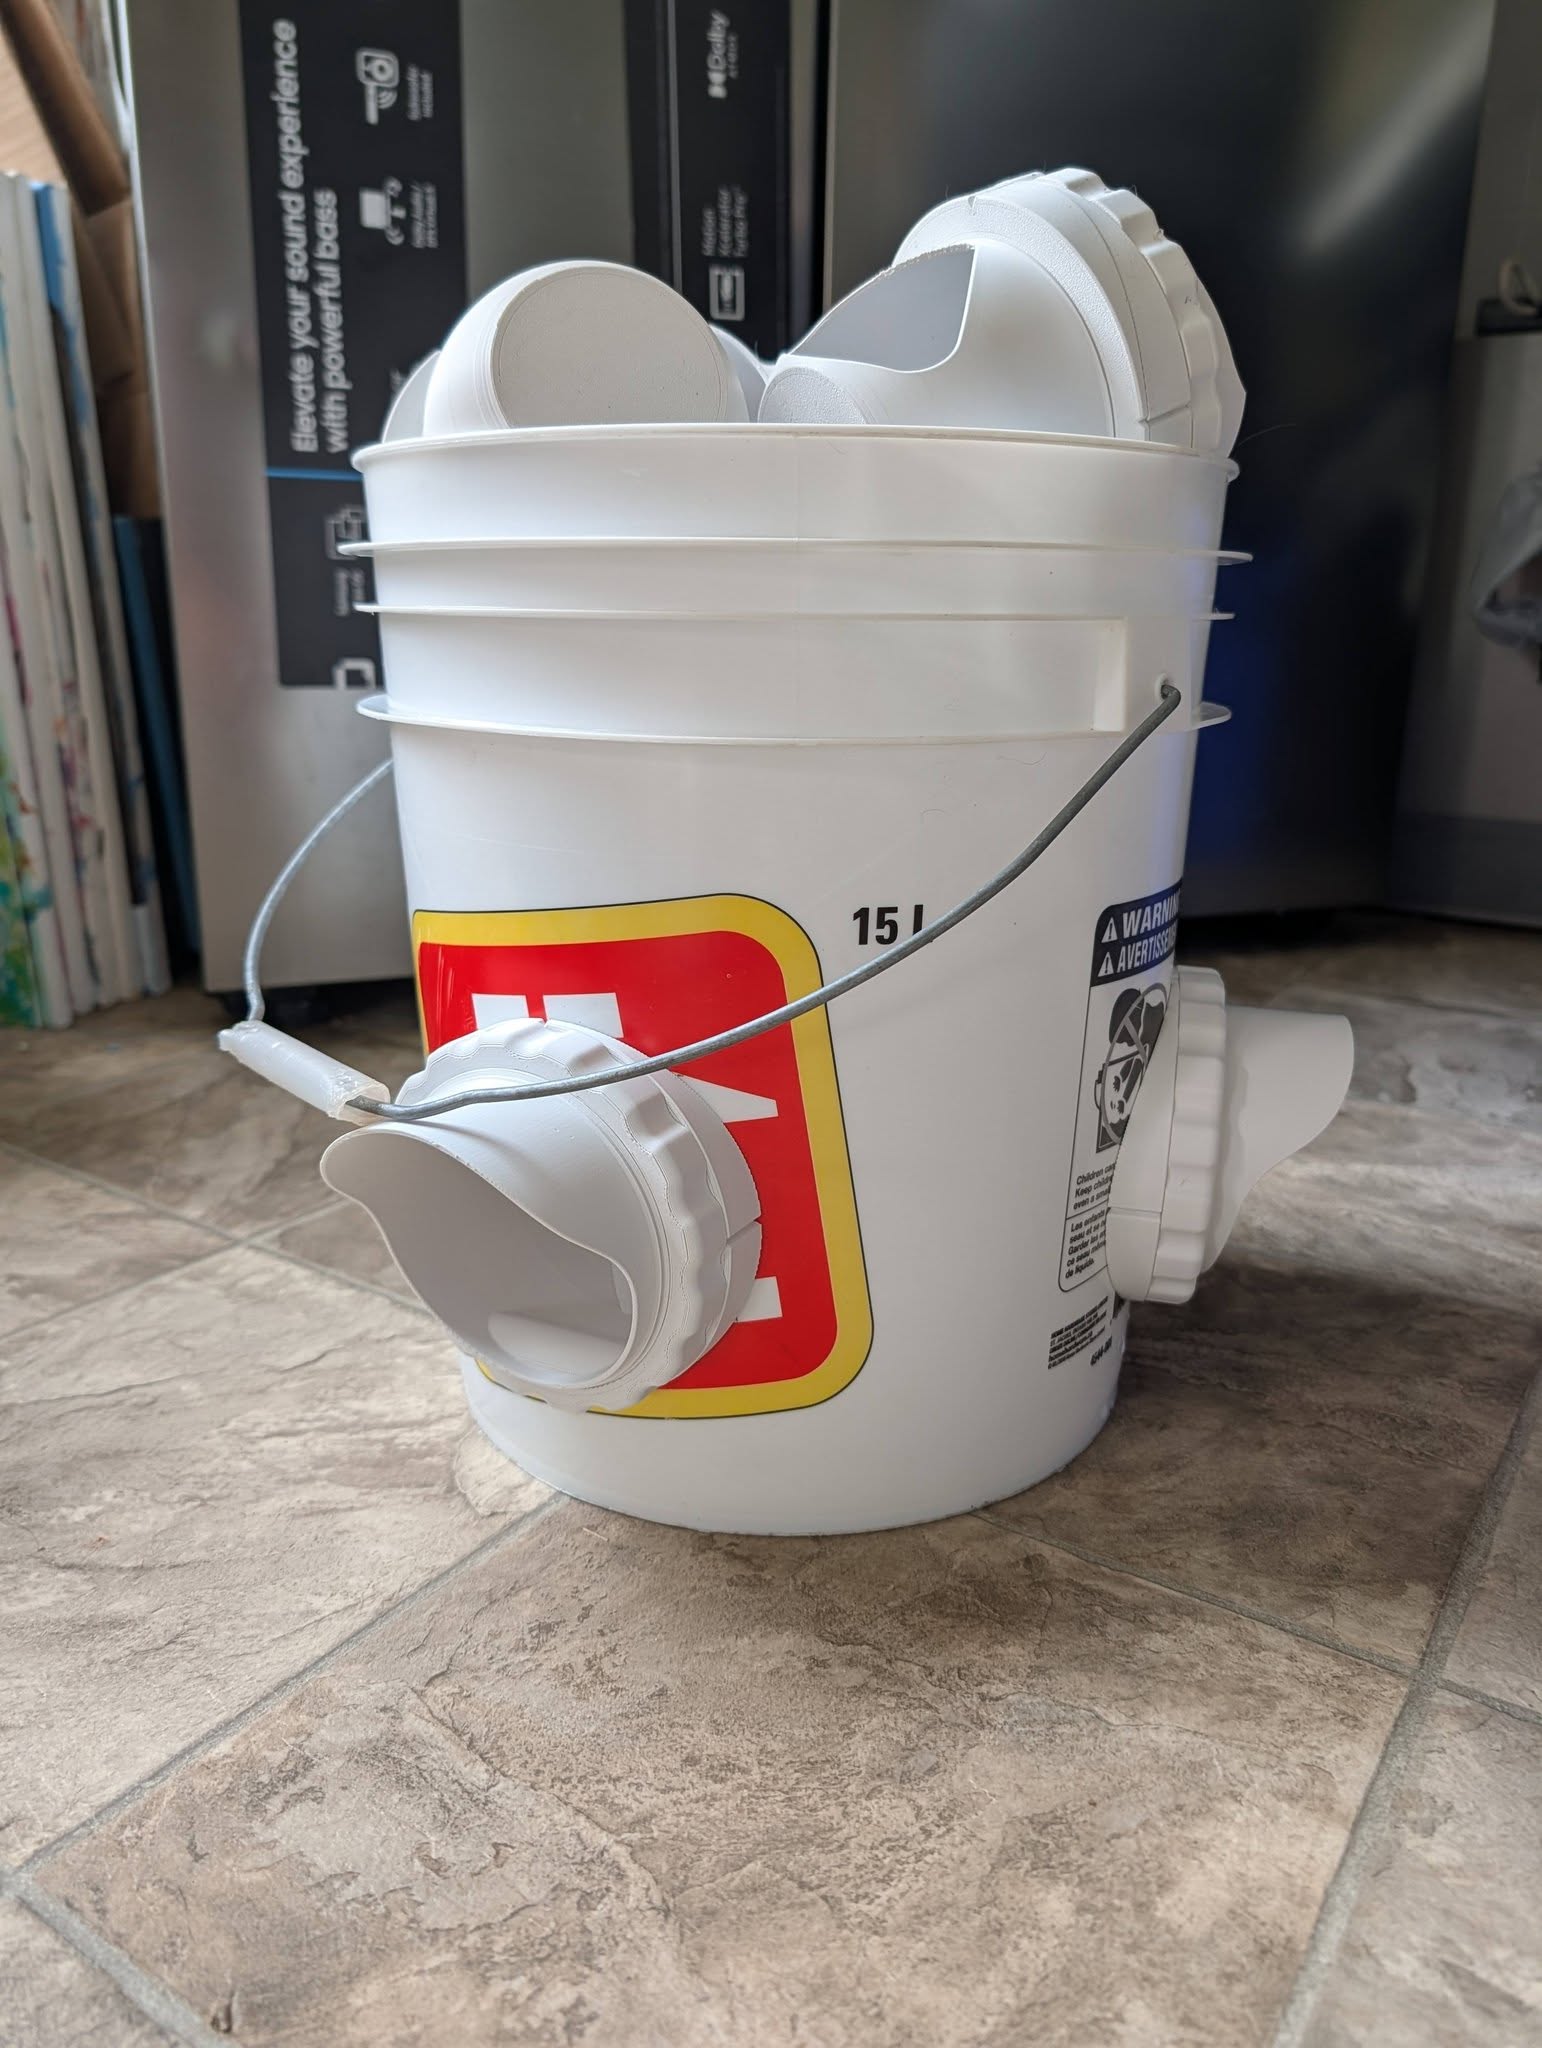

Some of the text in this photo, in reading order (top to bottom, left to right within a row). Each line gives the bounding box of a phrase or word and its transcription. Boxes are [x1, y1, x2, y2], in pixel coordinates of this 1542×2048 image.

[270, 18, 320, 453] Elevate your sound experience
[312, 187, 353, 453] with powerful bass
[852, 906, 899, 946] 15
[1076, 1168, 1104, 1186] Children
[1075, 1185, 1092, 1198] Keep
[1073, 1198, 1090, 1210] even
[1071, 1222, 1083, 1232] Les
[1070, 1231, 1085, 1244] seau
[1068, 1239, 1090, 1255] Garder
[1065, 1268, 1074, 1279] de
